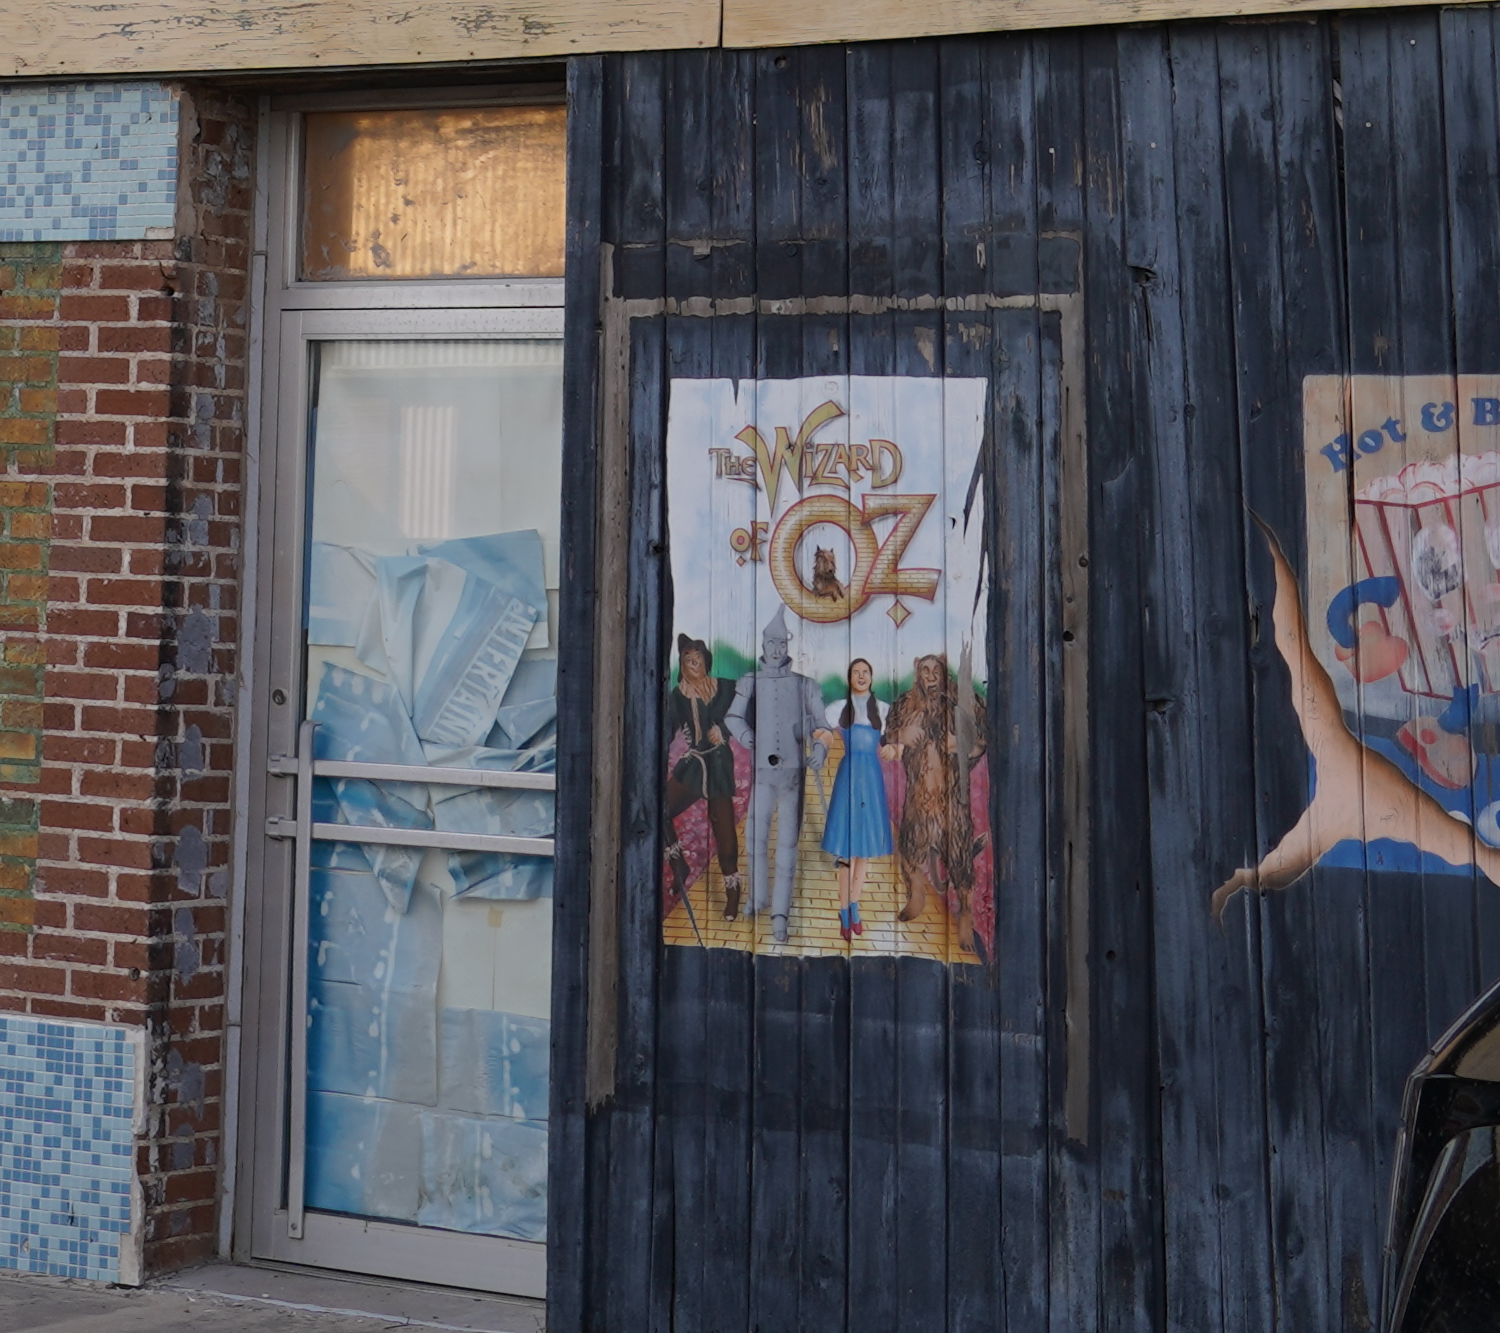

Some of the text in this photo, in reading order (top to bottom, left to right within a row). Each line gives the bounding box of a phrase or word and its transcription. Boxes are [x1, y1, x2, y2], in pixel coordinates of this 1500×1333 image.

[1319, 416, 1408, 474] Hot
[1420, 401, 1455, 433] &
[768, 493, 943, 624] OZ
